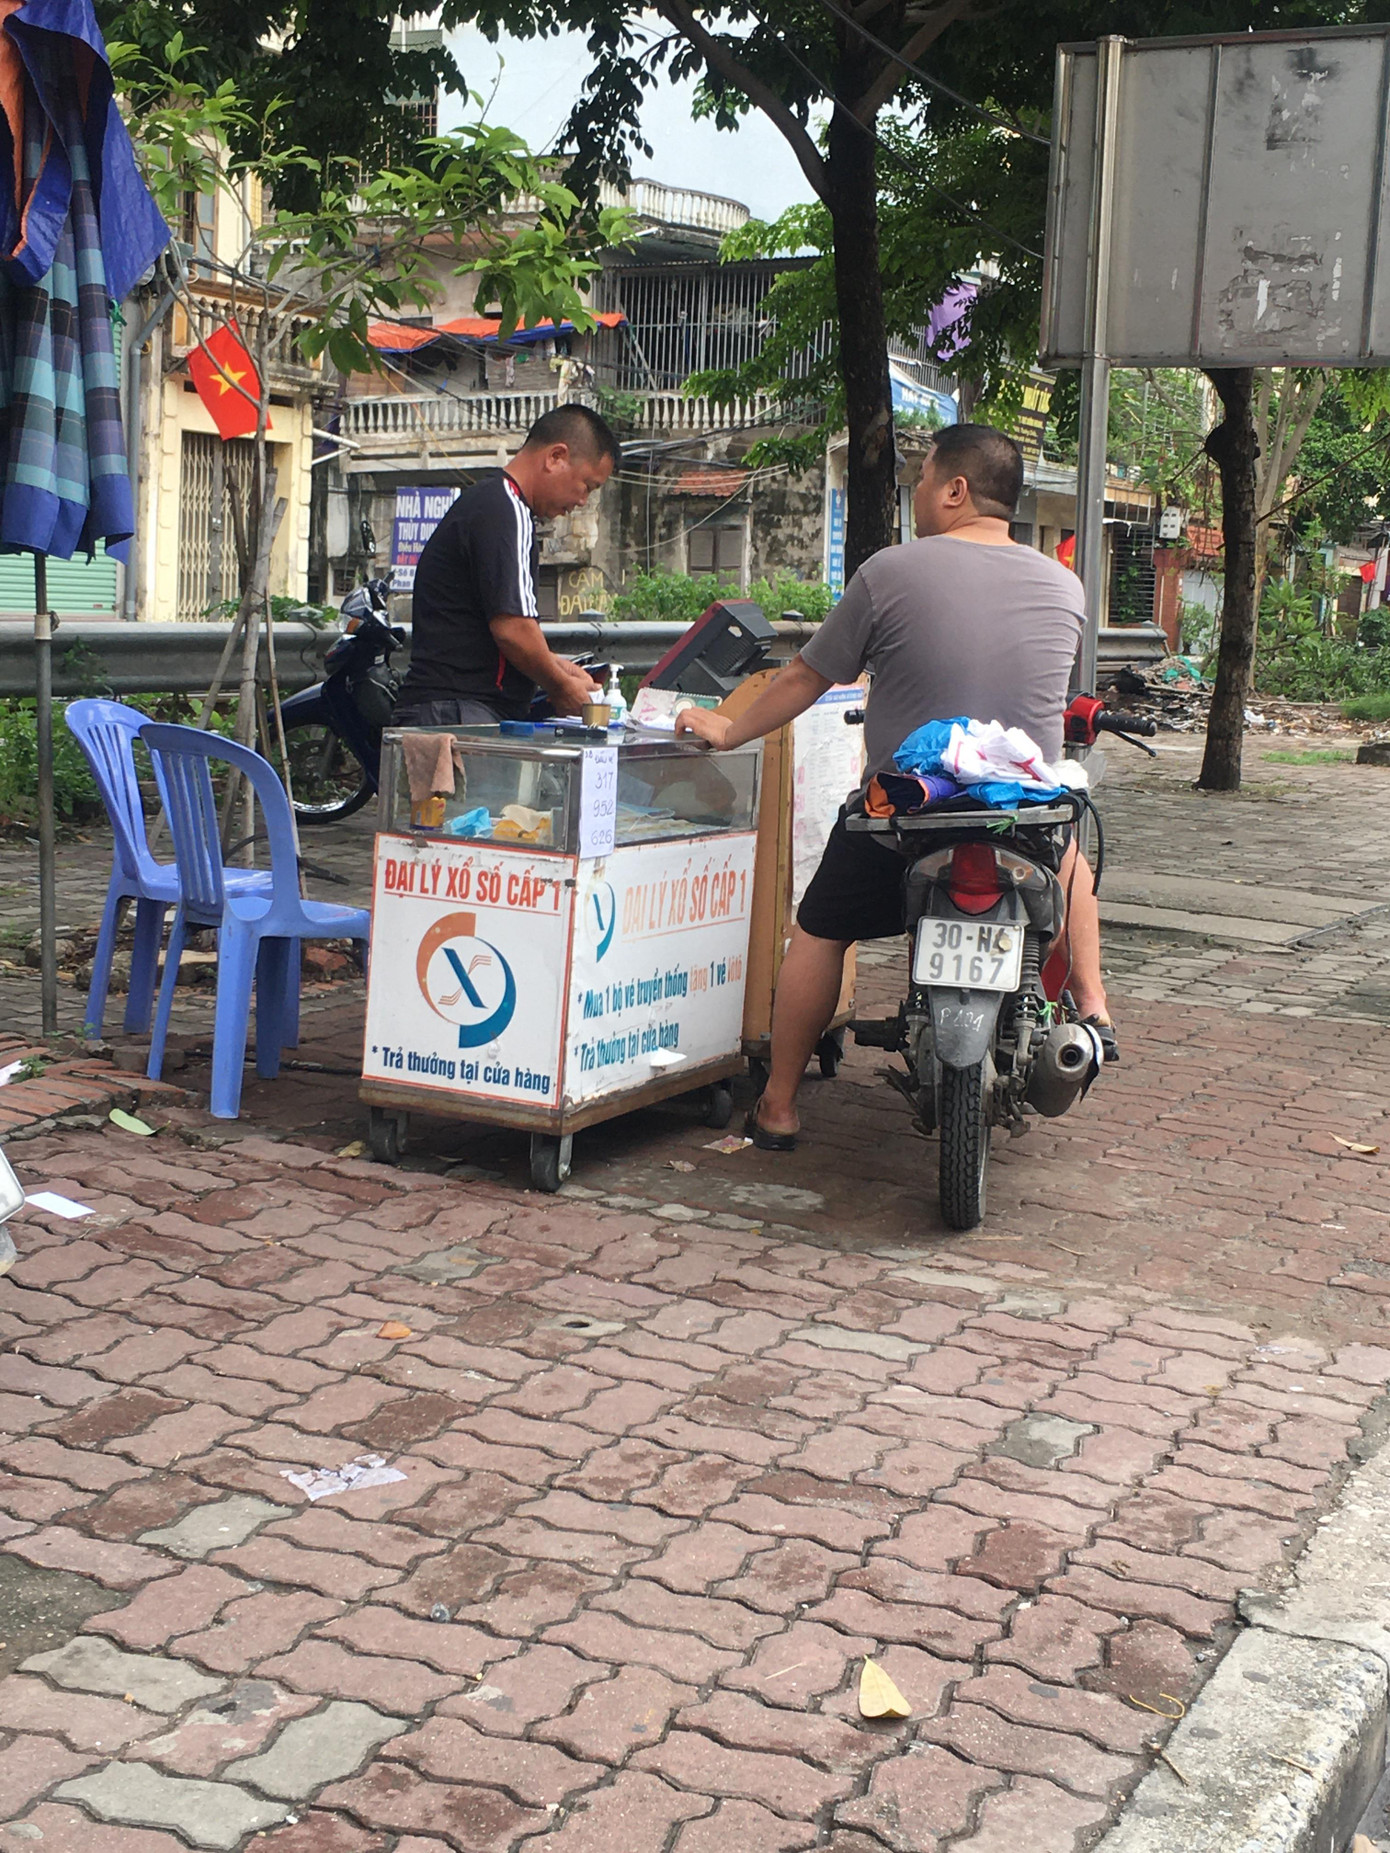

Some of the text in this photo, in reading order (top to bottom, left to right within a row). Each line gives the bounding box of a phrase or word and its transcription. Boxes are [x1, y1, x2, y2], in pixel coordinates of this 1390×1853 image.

[395, 491, 421, 518] NHÀ
[595, 772, 614, 790] 317
[593, 799, 614, 818] 952
[591, 829, 612, 846] 626
[385, 856, 561, 911] ĐẠI LÝ XỔ SỐ CẤP 1
[648, 870, 668, 930] LÝ
[689, 857, 713, 923] SỐ
[709, 853, 736, 919] CẤP
[741, 868, 747, 914] 1
[583, 989, 604, 1019] Mua
[606, 985, 610, 1014] 1
[612, 980, 623, 1017] bộ
[625, 978, 635, 1009] vé
[665, 962, 688, 998] thống
[710, 960, 715, 988] 1
[717, 956, 726, 986] vé
[929, 953, 1004, 985] 9167
[580, 1036, 596, 1072] Trả
[628, 1028, 640, 1064] tại
[382, 1045, 551, 1095] Trả thưởng tại cửa hàng
